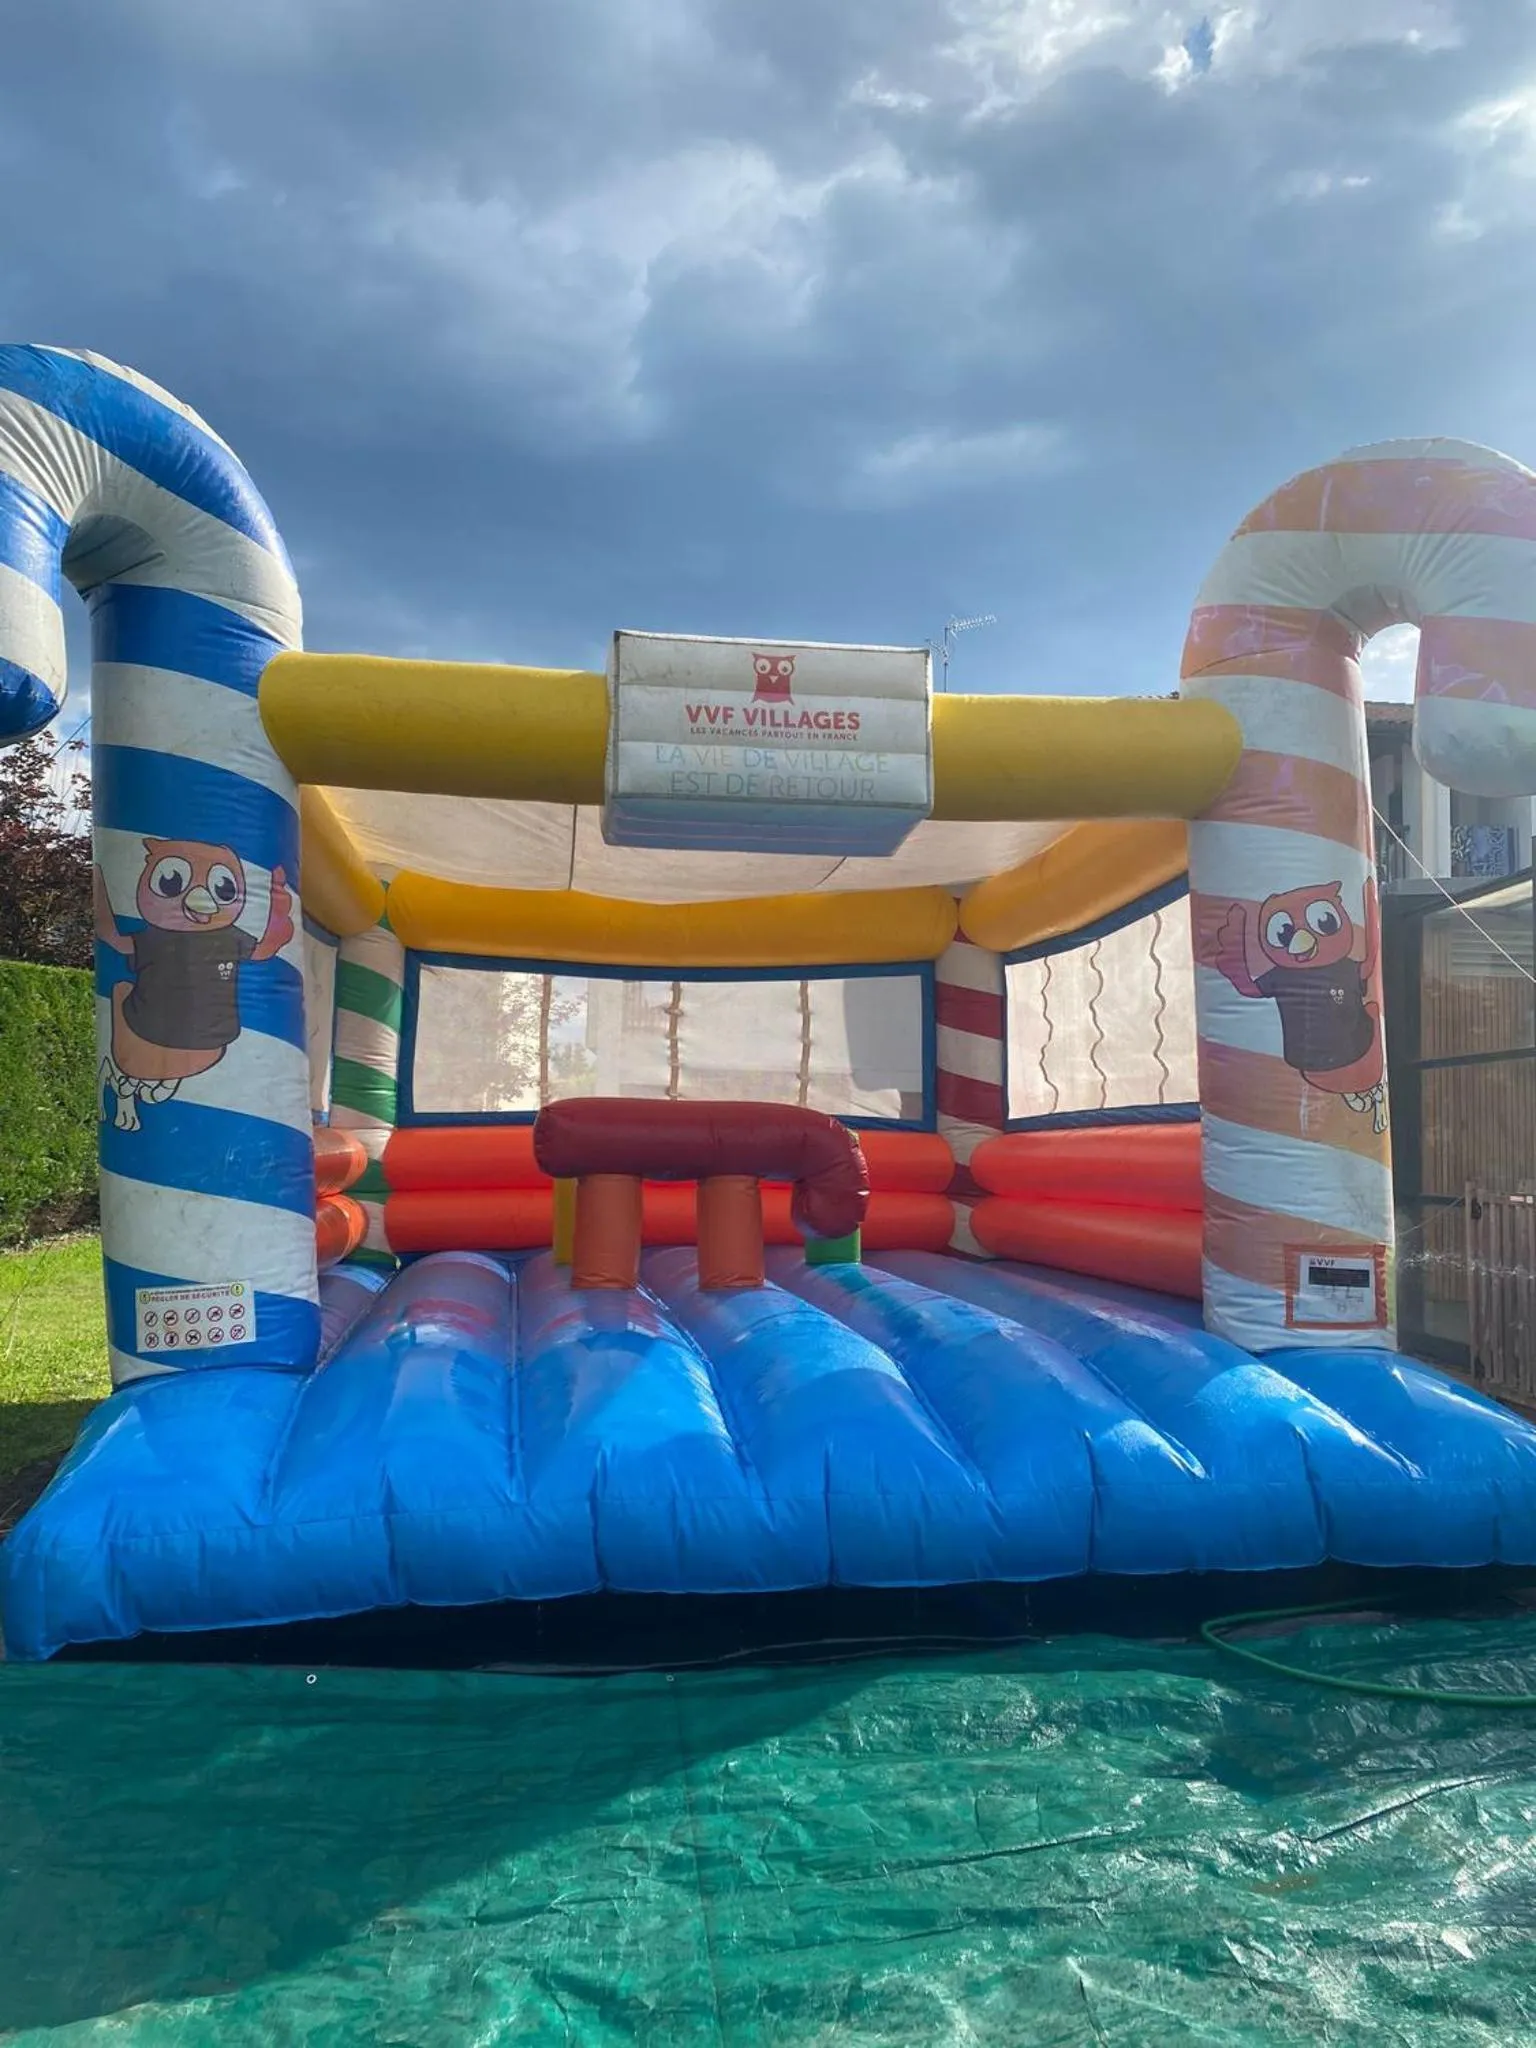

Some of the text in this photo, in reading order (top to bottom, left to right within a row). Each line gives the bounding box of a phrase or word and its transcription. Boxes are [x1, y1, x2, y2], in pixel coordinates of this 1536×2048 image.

[685, 704, 861, 730] VVF VILLAGES
[690, 727, 707, 735] LES
[710, 728, 759, 737] VACANCES
[762, 730, 805, 739] PARTOUT
[822, 733, 859, 742] FRANCE
[655, 744, 891, 774] LA VIE DE VILLAGE
[670, 771, 876, 800] EST DE RETOUR
